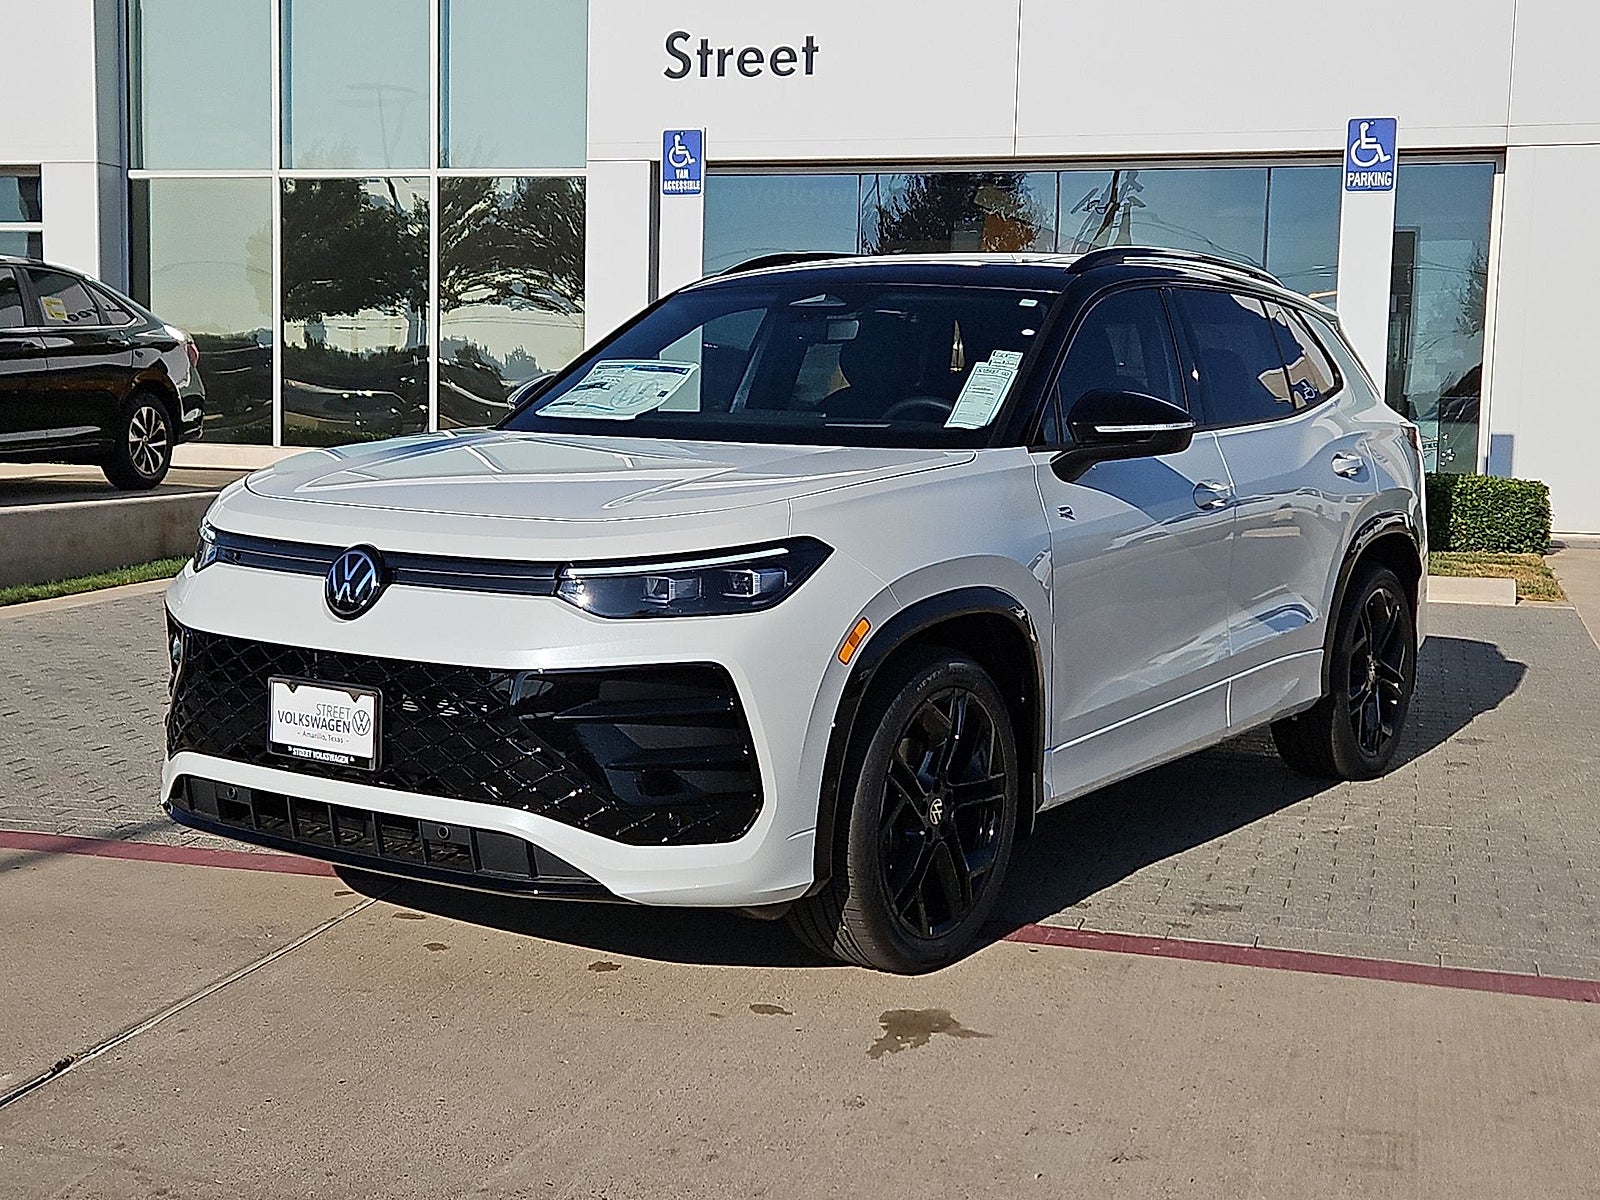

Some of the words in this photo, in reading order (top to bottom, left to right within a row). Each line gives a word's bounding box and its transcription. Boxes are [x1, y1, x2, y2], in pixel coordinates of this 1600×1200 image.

[663, 30, 819, 79] Street
[1347, 171, 1393, 187] PARKING
[277, 710, 351, 734] VOLKSWAGEN
[315, 703, 351, 721] STREET
